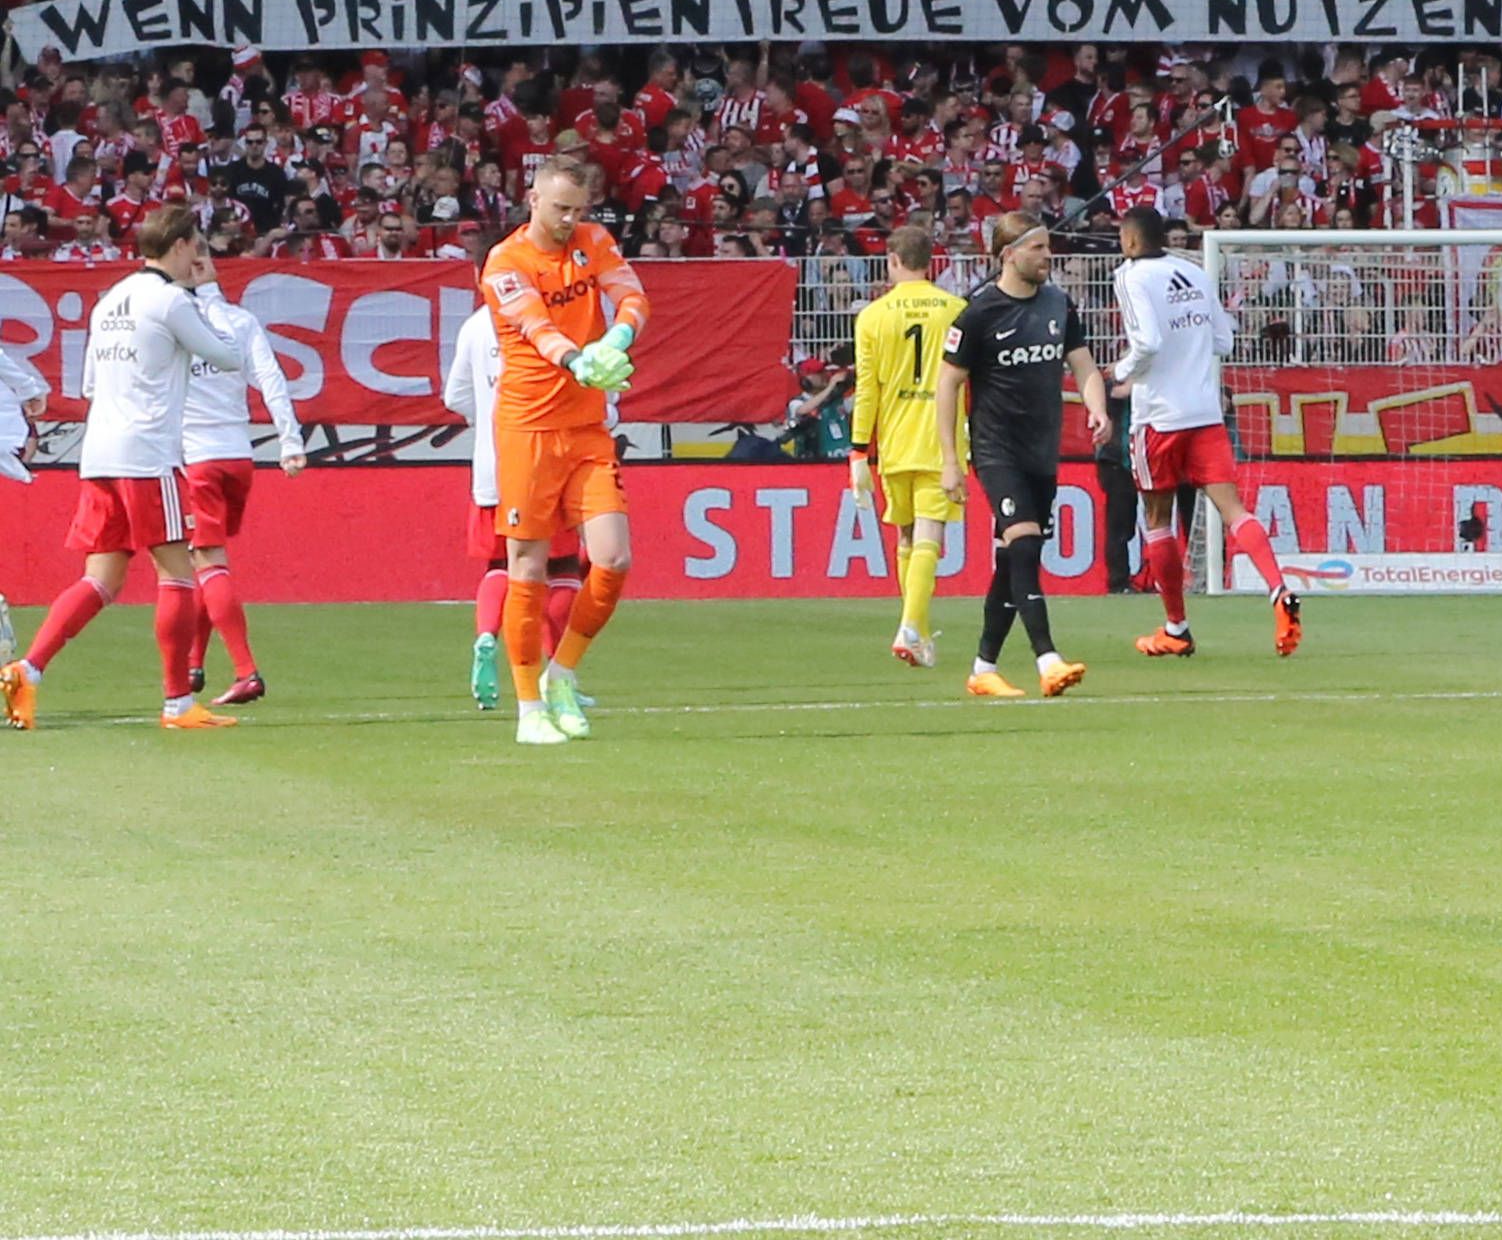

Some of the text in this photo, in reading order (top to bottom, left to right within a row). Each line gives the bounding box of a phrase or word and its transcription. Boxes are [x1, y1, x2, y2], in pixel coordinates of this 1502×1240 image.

[1168, 310, 1212, 330] wefox
[904, 323, 923, 385] 1
[1254, 485, 1386, 555] AN
